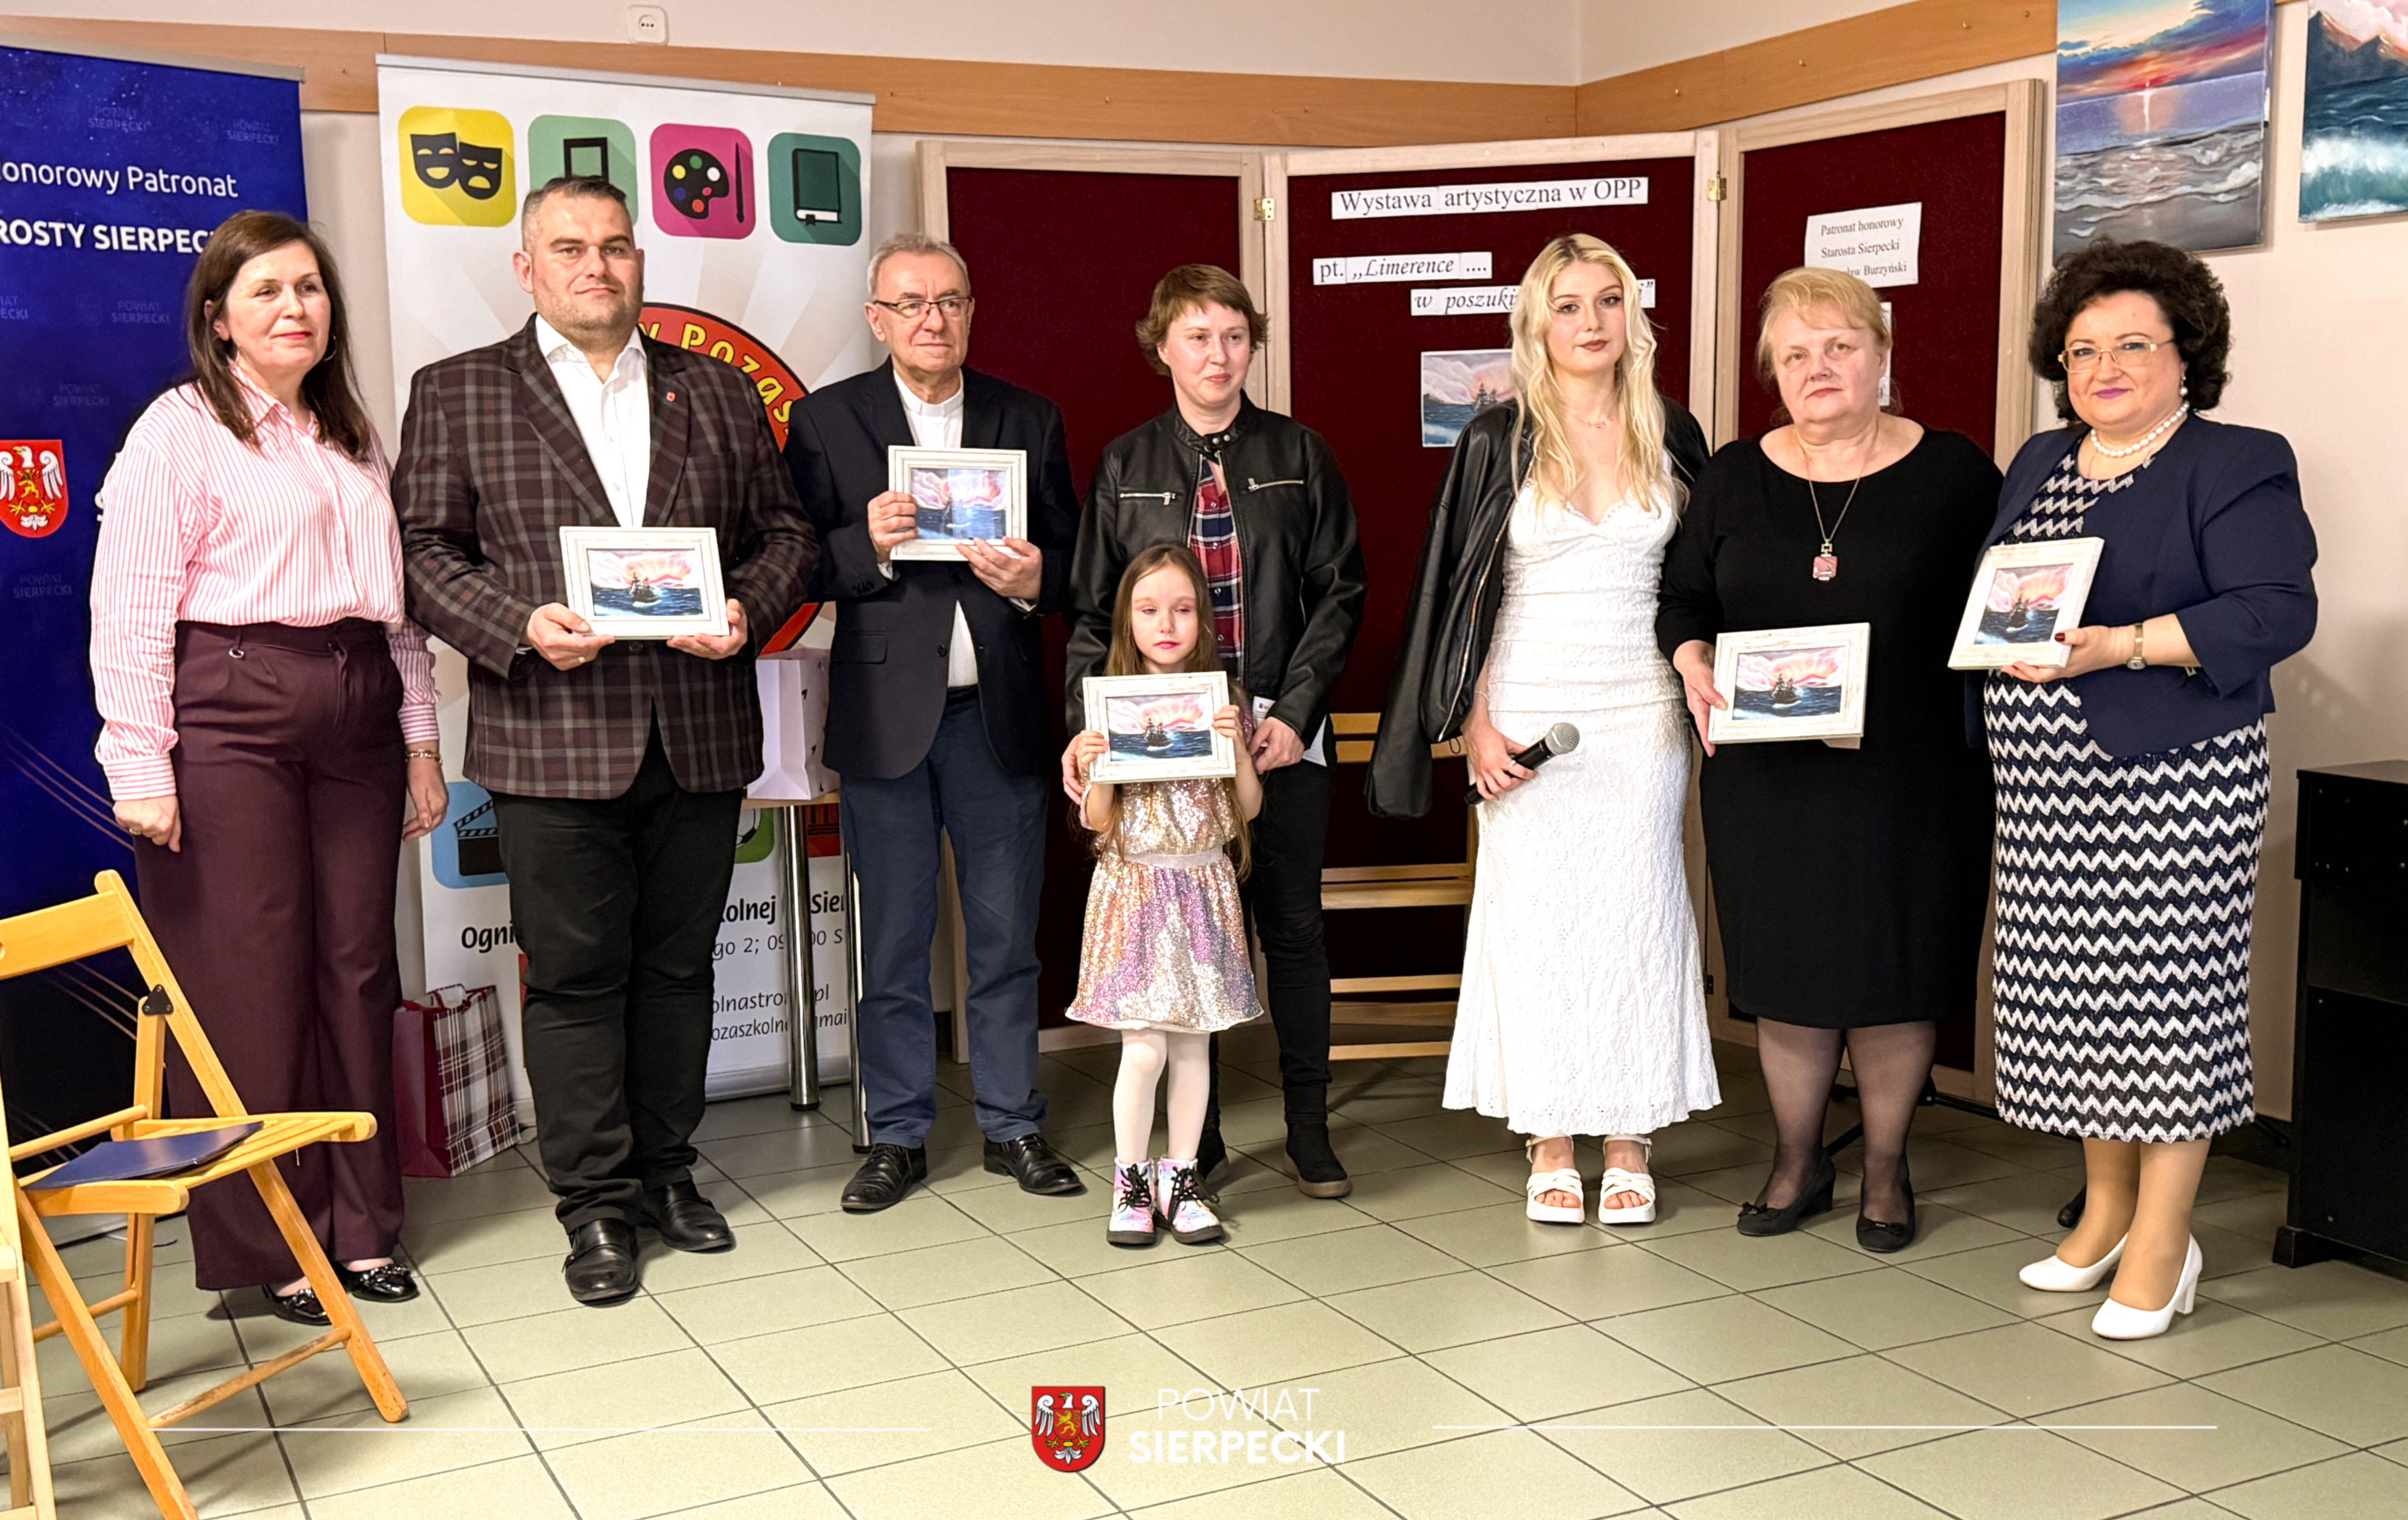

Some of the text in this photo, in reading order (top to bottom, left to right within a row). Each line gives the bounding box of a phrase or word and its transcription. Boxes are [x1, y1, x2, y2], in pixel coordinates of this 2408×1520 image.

[0, 162, 239, 198] onorowy Patronat
[1340, 179, 1641, 215] Wystawa artystyczna w OPP
[1820, 217, 1904, 236] Patronat honorowy
[93, 224, 214, 253] SIERPEC
[1821, 239, 1900, 258] Starosta Sierpecki
[1319, 261, 1344, 282] pt.
[117, 300, 160, 312] POWIAT
[1414, 287, 1519, 315] w poszuki
[111, 312, 170, 324] SIERPECKI
[680, 322, 794, 437] Pozas
[53, 395, 110, 407] SIERPECKI
[13, 585, 73, 598] SIERPECKI
[722, 895, 776, 925] olnej
[743, 937, 759, 954] 2;
